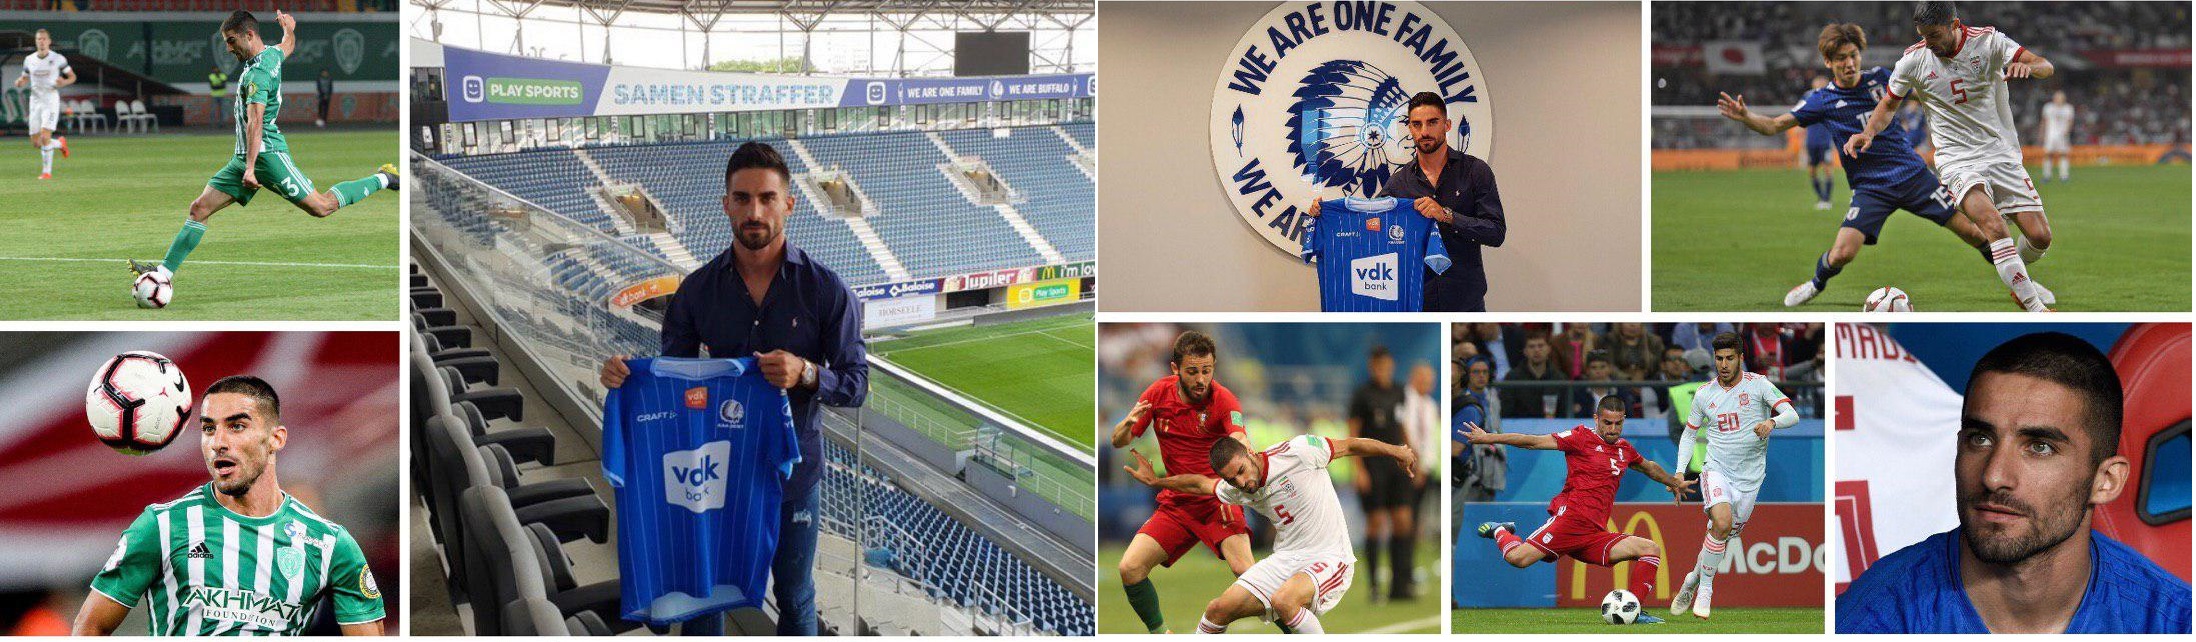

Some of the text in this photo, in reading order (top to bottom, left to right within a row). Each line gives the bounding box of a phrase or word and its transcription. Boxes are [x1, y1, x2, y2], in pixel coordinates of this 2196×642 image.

[1228, 1, 1478, 104] WE ARE ONE FAMILY
[490, 83, 579, 99] PLAY SPORTS
[614, 82, 834, 105] SAMEN STRAFFER
[907, 85, 984, 98] WE ARE ONE FAMILY
[1009, 83, 1070, 95] WE ARE BUFFALO
[1950, 79, 1968, 105] 5
[1232, 157, 1284, 218] WE
[964, 270, 1016, 290] Jupiler
[1060, 265, 1078, 278] i'm
[1355, 262, 1394, 281] vdk
[1364, 281, 1388, 291] bank
[637, 411, 668, 422] CRAFT
[1717, 412, 1741, 433] 20
[671, 454, 720, 487] vdk
[1609, 457, 1621, 476] 5
[1273, 504, 1295, 526] 5
[187, 551, 214, 560] adidas
[1309, 561, 1329, 574] 5
[184, 588, 303, 621] AKHMAT
